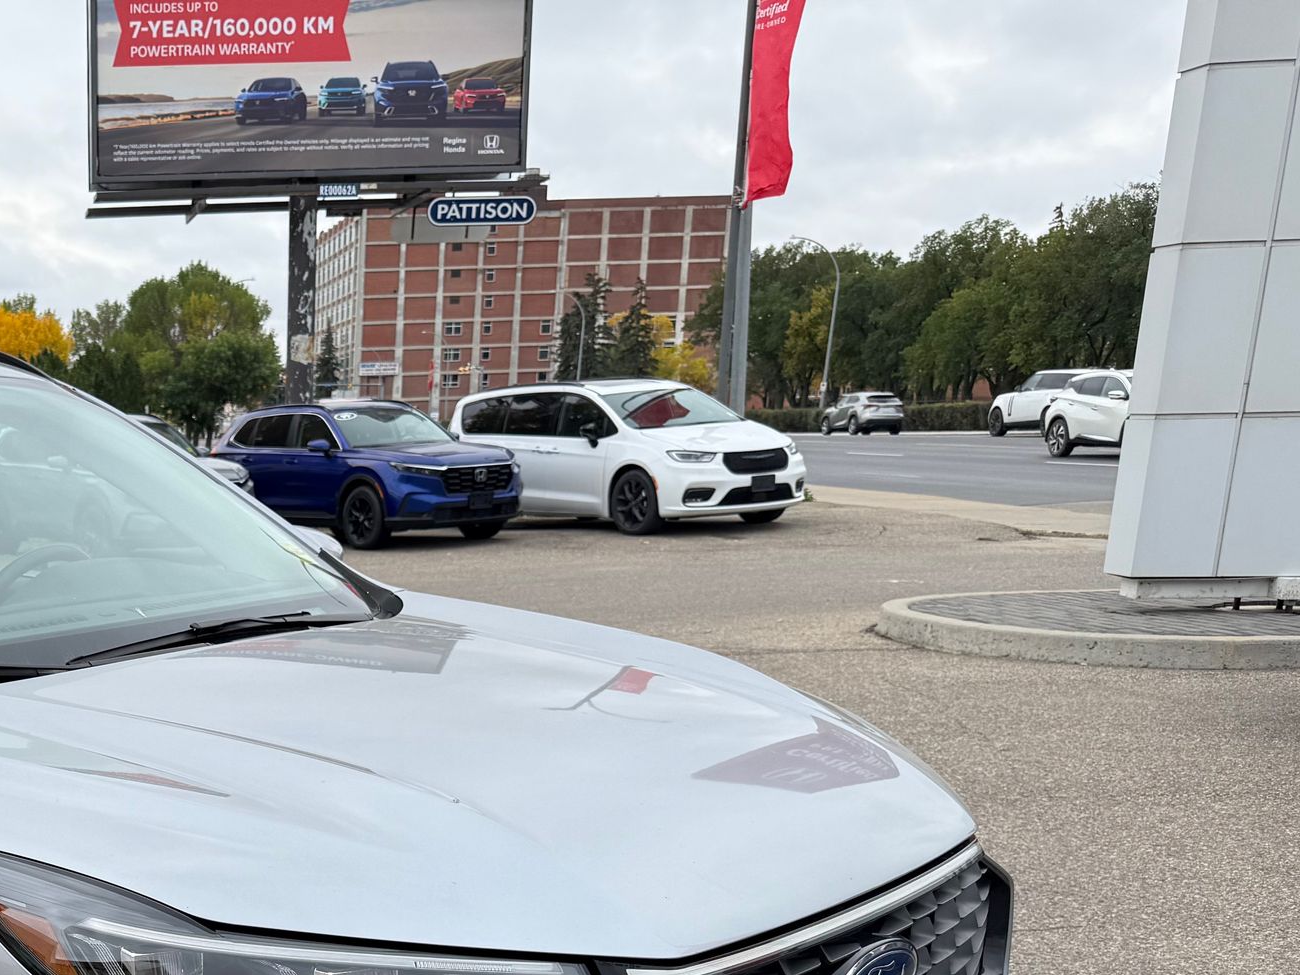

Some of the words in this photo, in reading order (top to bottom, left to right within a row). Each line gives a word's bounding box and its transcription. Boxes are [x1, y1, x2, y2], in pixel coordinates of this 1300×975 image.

[130, 1, 184, 14] INCLUDES
[186, 1, 201, 13] UP
[204, 1, 218, 12] TO
[129, 16, 296, 39] 7-YEAR/160,000
[302, 16, 334, 34] KM
[130, 44, 215, 58] POWERTRAIN
[443, 136, 467, 146] Regina
[443, 146, 465, 154] Honda
[319, 183, 356, 196] RE00062A
[437, 200, 528, 221] PATTISON
